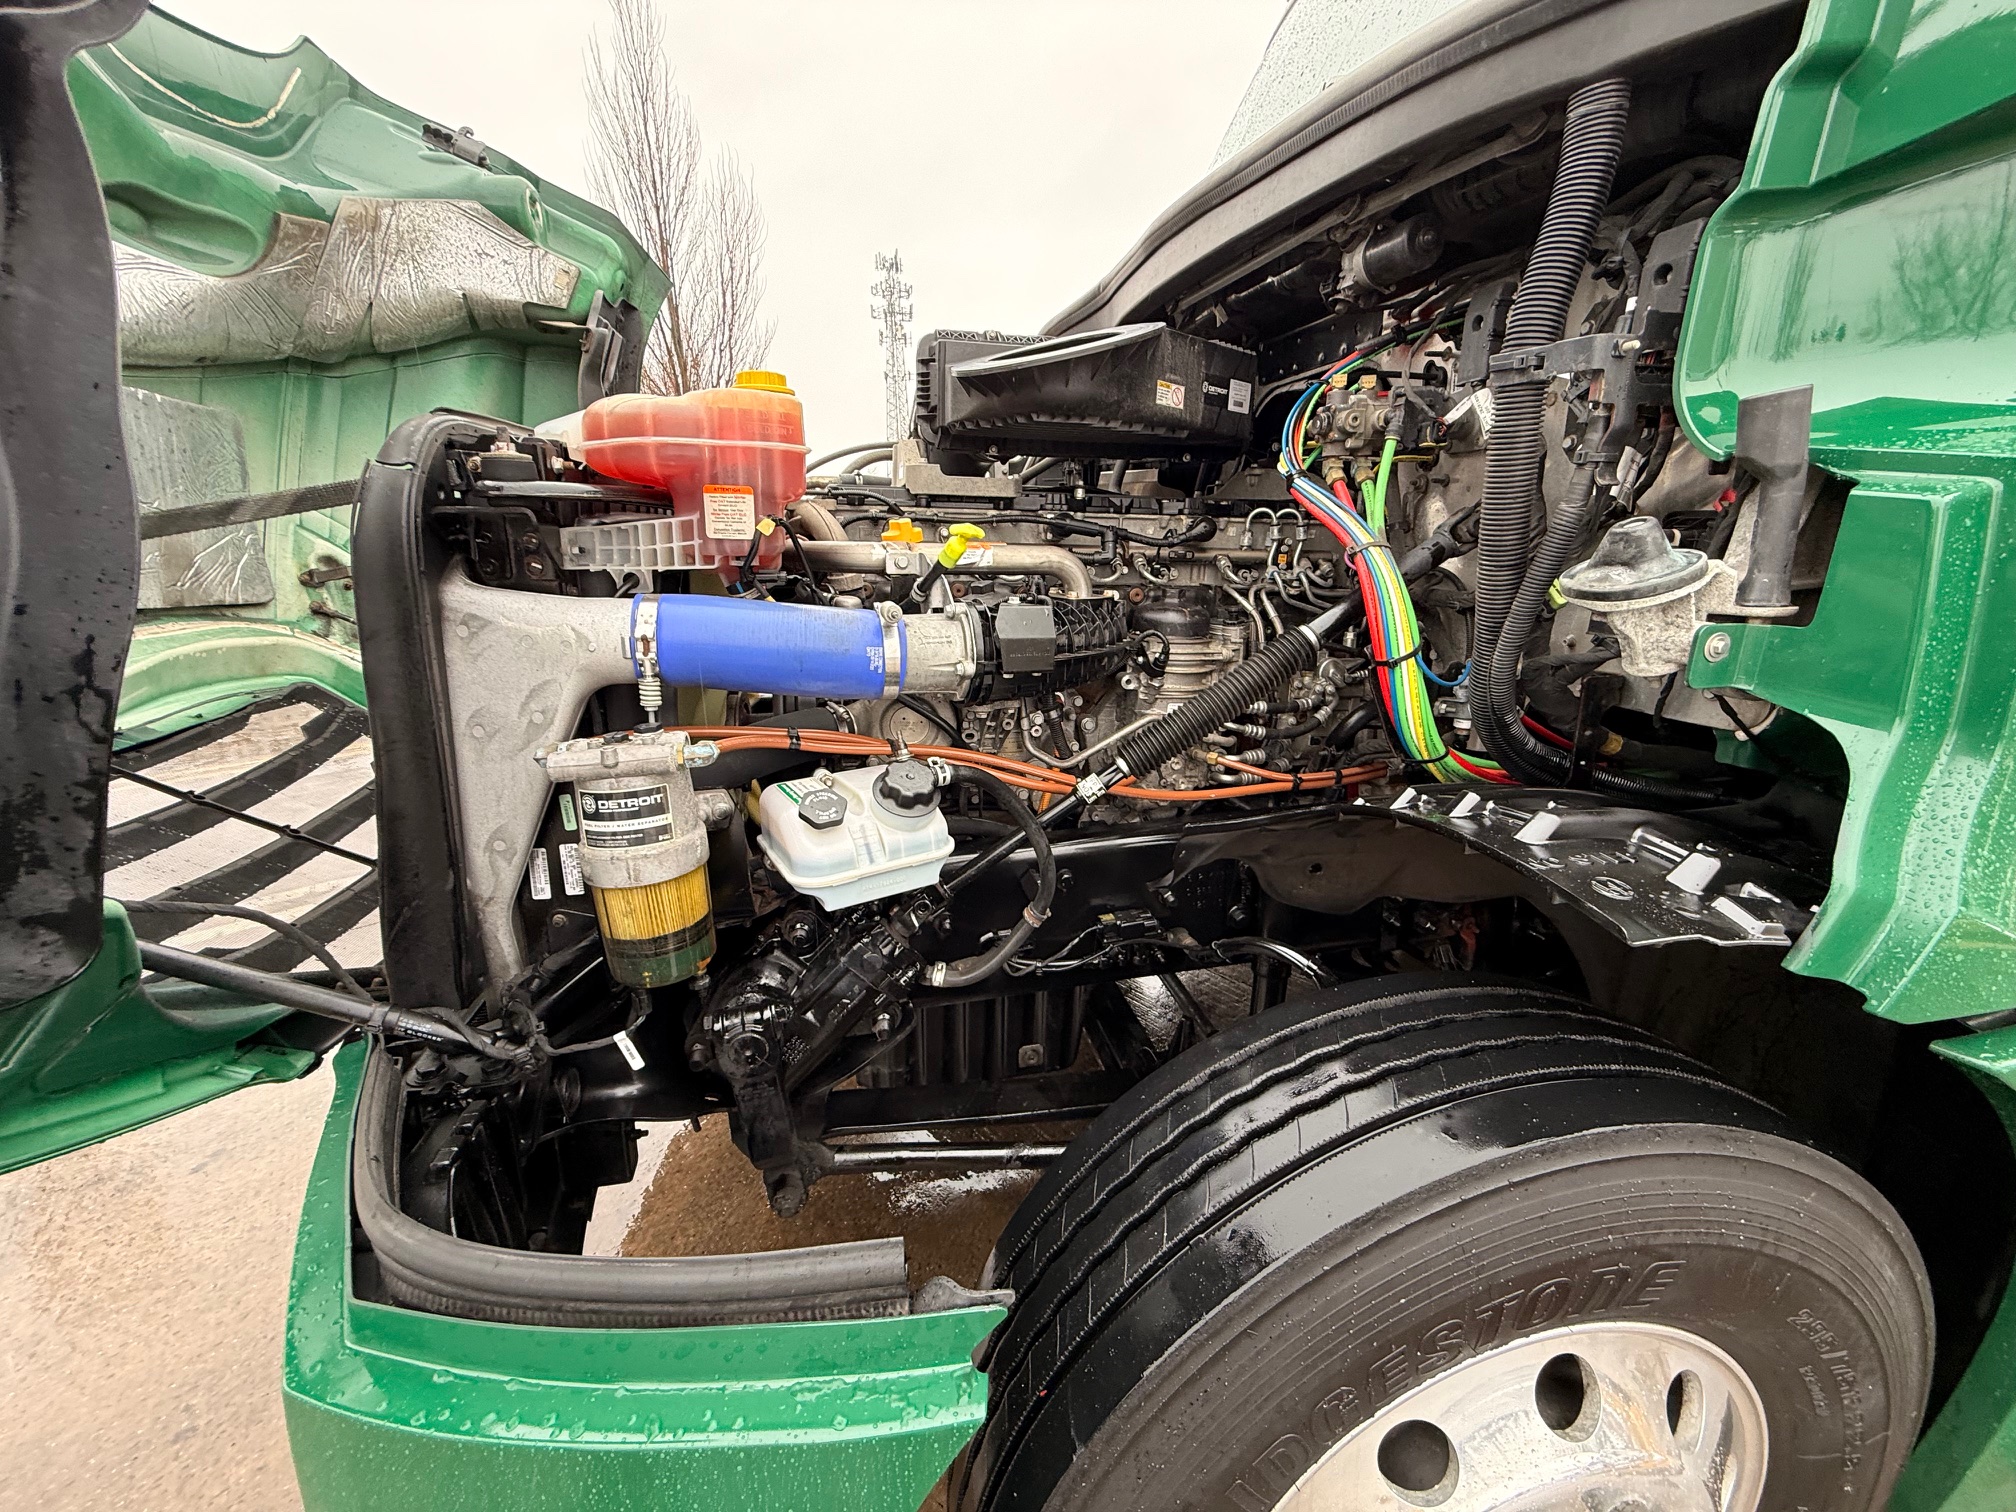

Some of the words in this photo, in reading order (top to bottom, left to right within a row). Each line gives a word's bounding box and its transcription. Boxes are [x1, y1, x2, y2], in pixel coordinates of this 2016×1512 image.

[1208, 385, 1228, 395] DETROIT
[598, 794, 664, 809] DETROIT
[637, 816, 669, 826] SEPARATOR
